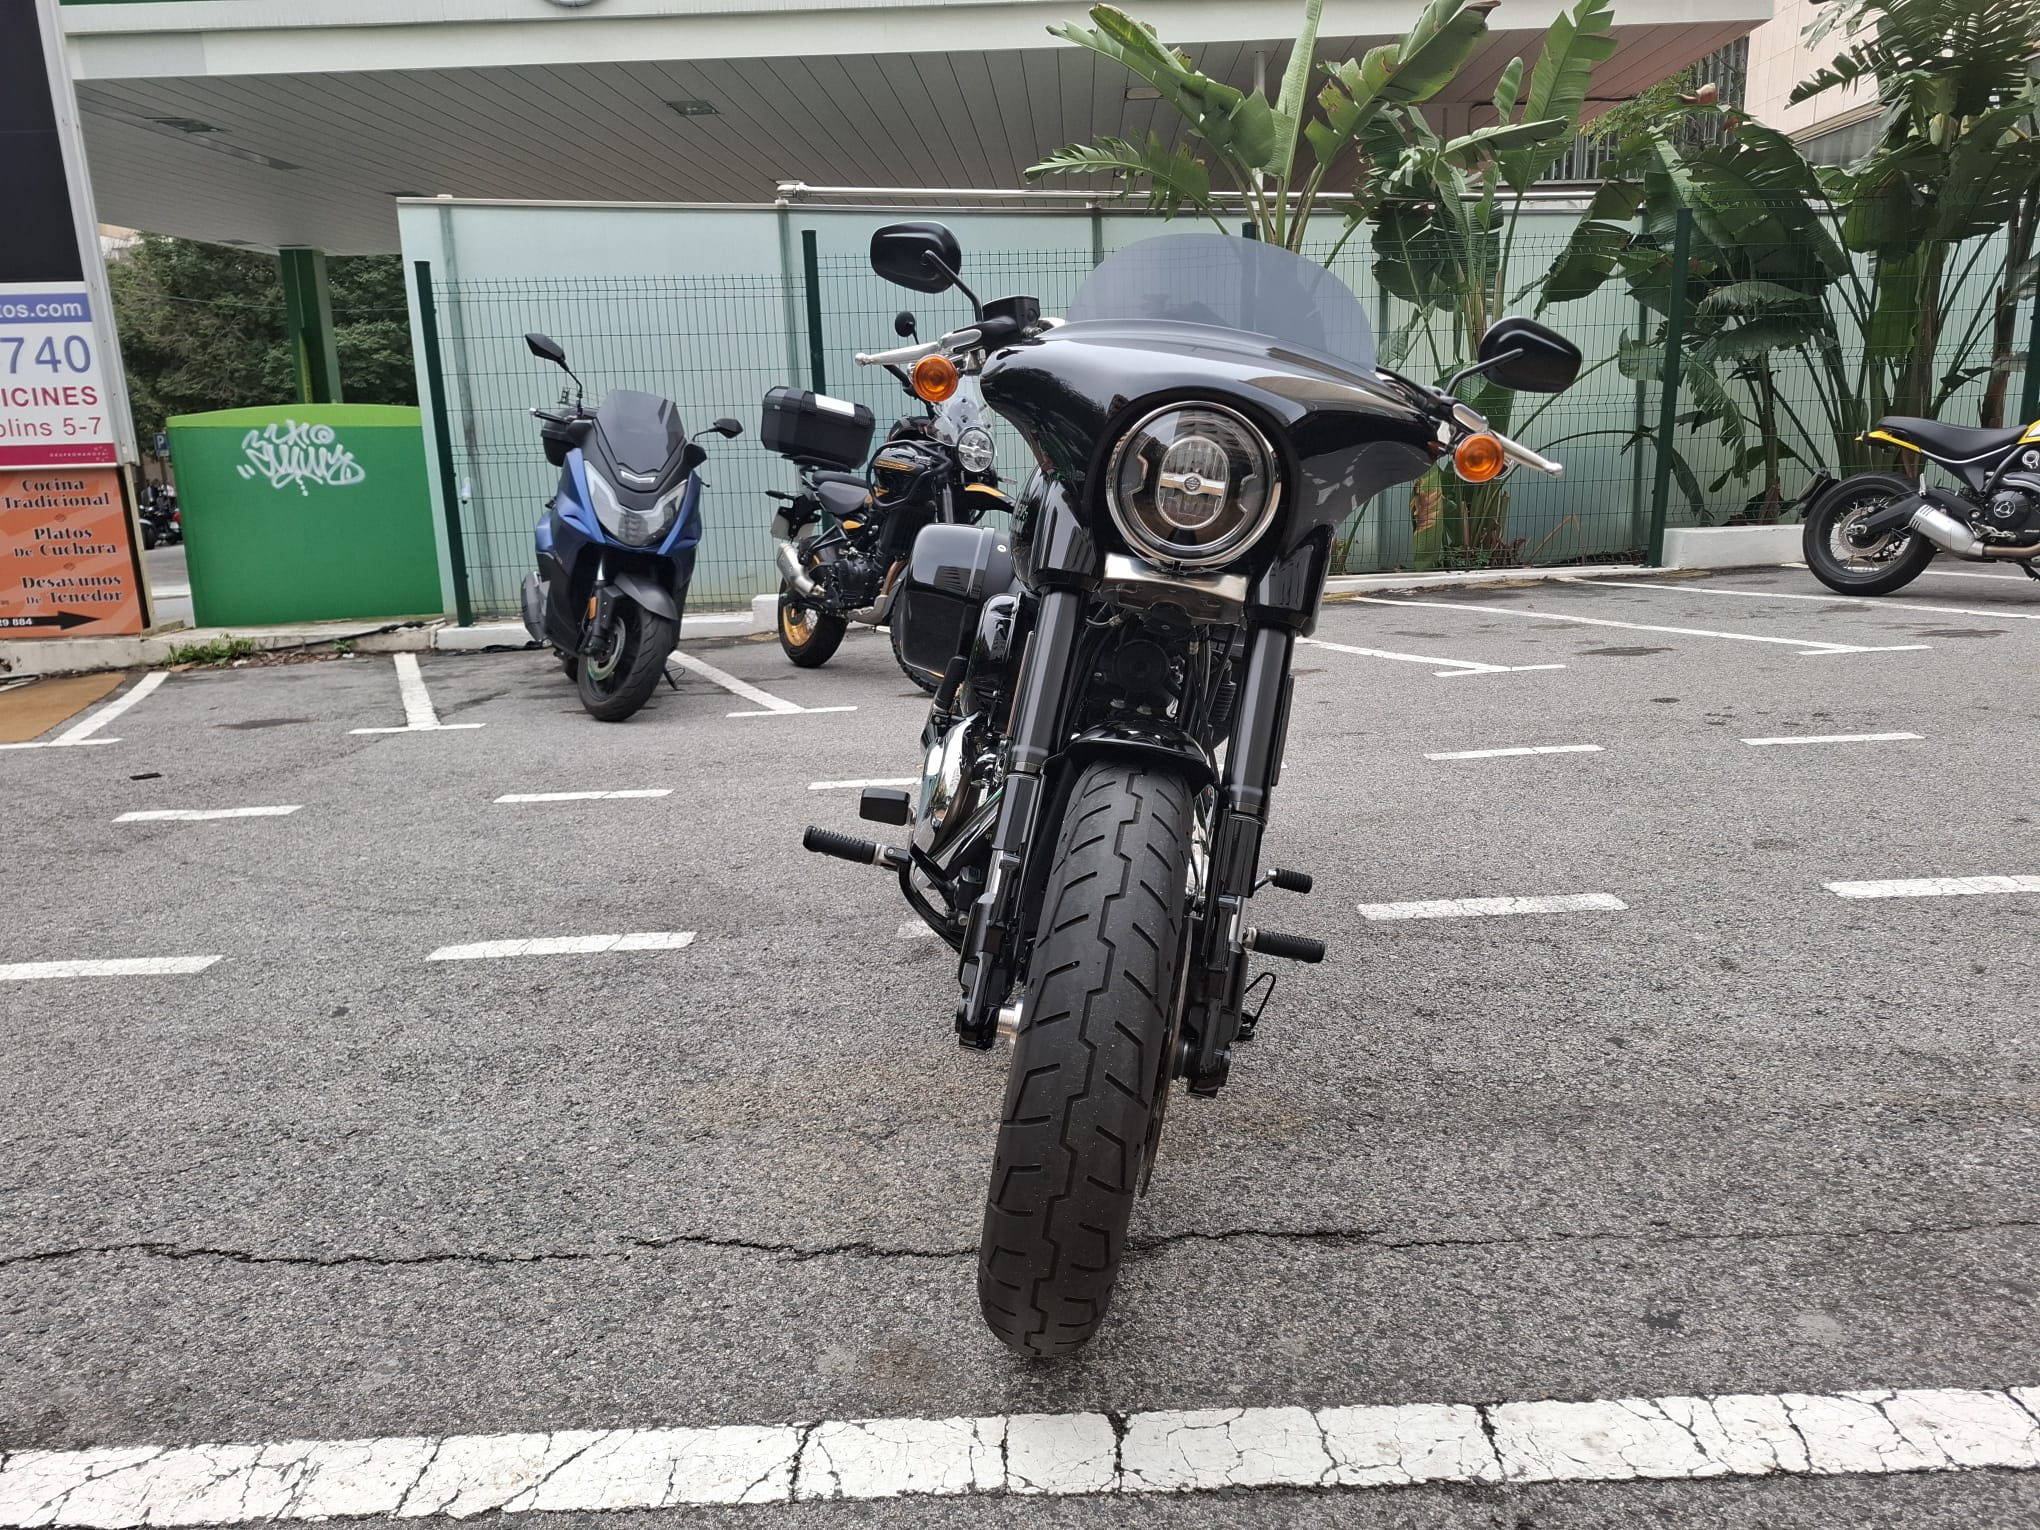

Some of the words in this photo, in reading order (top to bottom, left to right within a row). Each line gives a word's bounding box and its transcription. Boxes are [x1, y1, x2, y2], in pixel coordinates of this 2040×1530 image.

[0, 302, 83, 318] os.com
[63, 417, 101, 436] 5-7
[22, 478, 85, 492] Cocina
[2, 492, 110, 509] Tradicional
[34, 527, 92, 540] Platos
[14, 547, 32, 557] De
[39, 542, 116, 556] Cuchara
[22, 576, 121, 592] Desayunos
[50, 589, 122, 603] Tenedor
